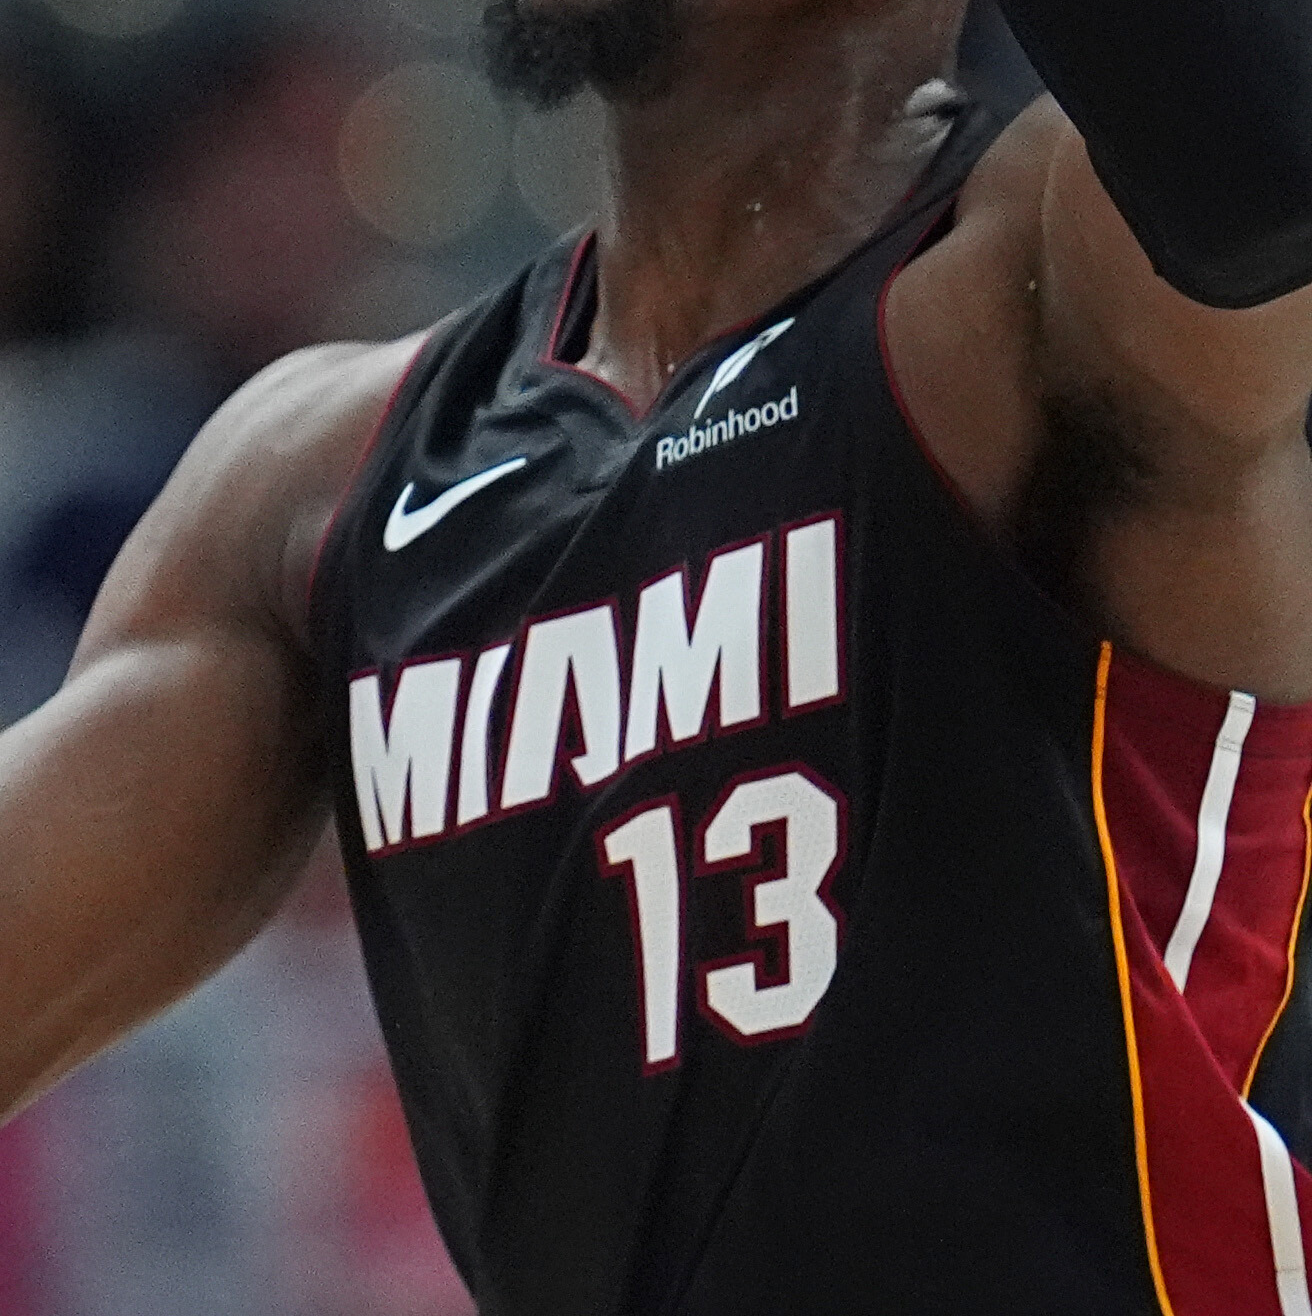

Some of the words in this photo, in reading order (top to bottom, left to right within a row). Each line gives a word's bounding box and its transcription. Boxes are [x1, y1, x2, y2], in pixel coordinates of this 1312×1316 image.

[656, 389, 799, 469] Robinhood
[348, 512, 843, 857] MIAMI
[598, 764, 848, 1074] 13
